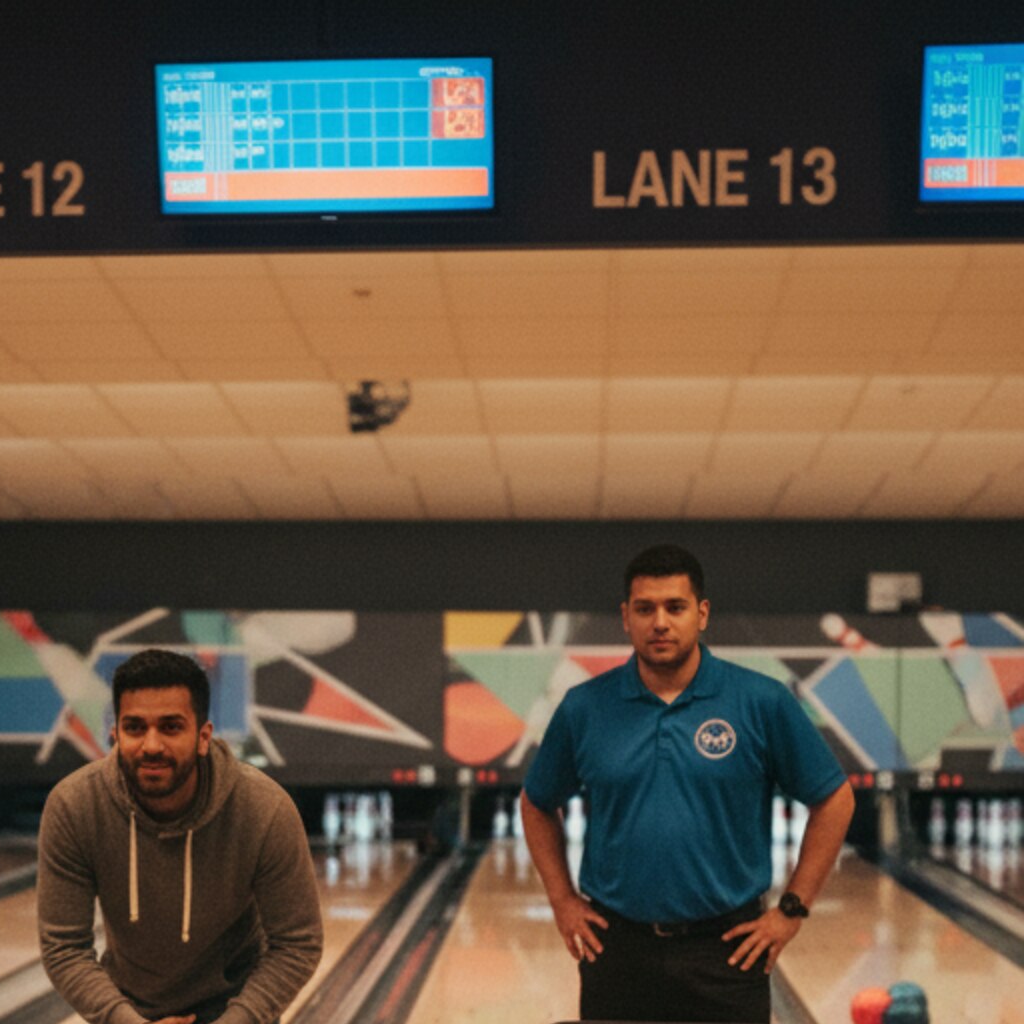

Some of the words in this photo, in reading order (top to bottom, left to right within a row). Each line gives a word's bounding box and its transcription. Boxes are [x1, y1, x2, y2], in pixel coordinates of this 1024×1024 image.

[22, 160, 85, 217] 12
[592, 149, 749, 208] LANE
[770, 147, 837, 205] 13
